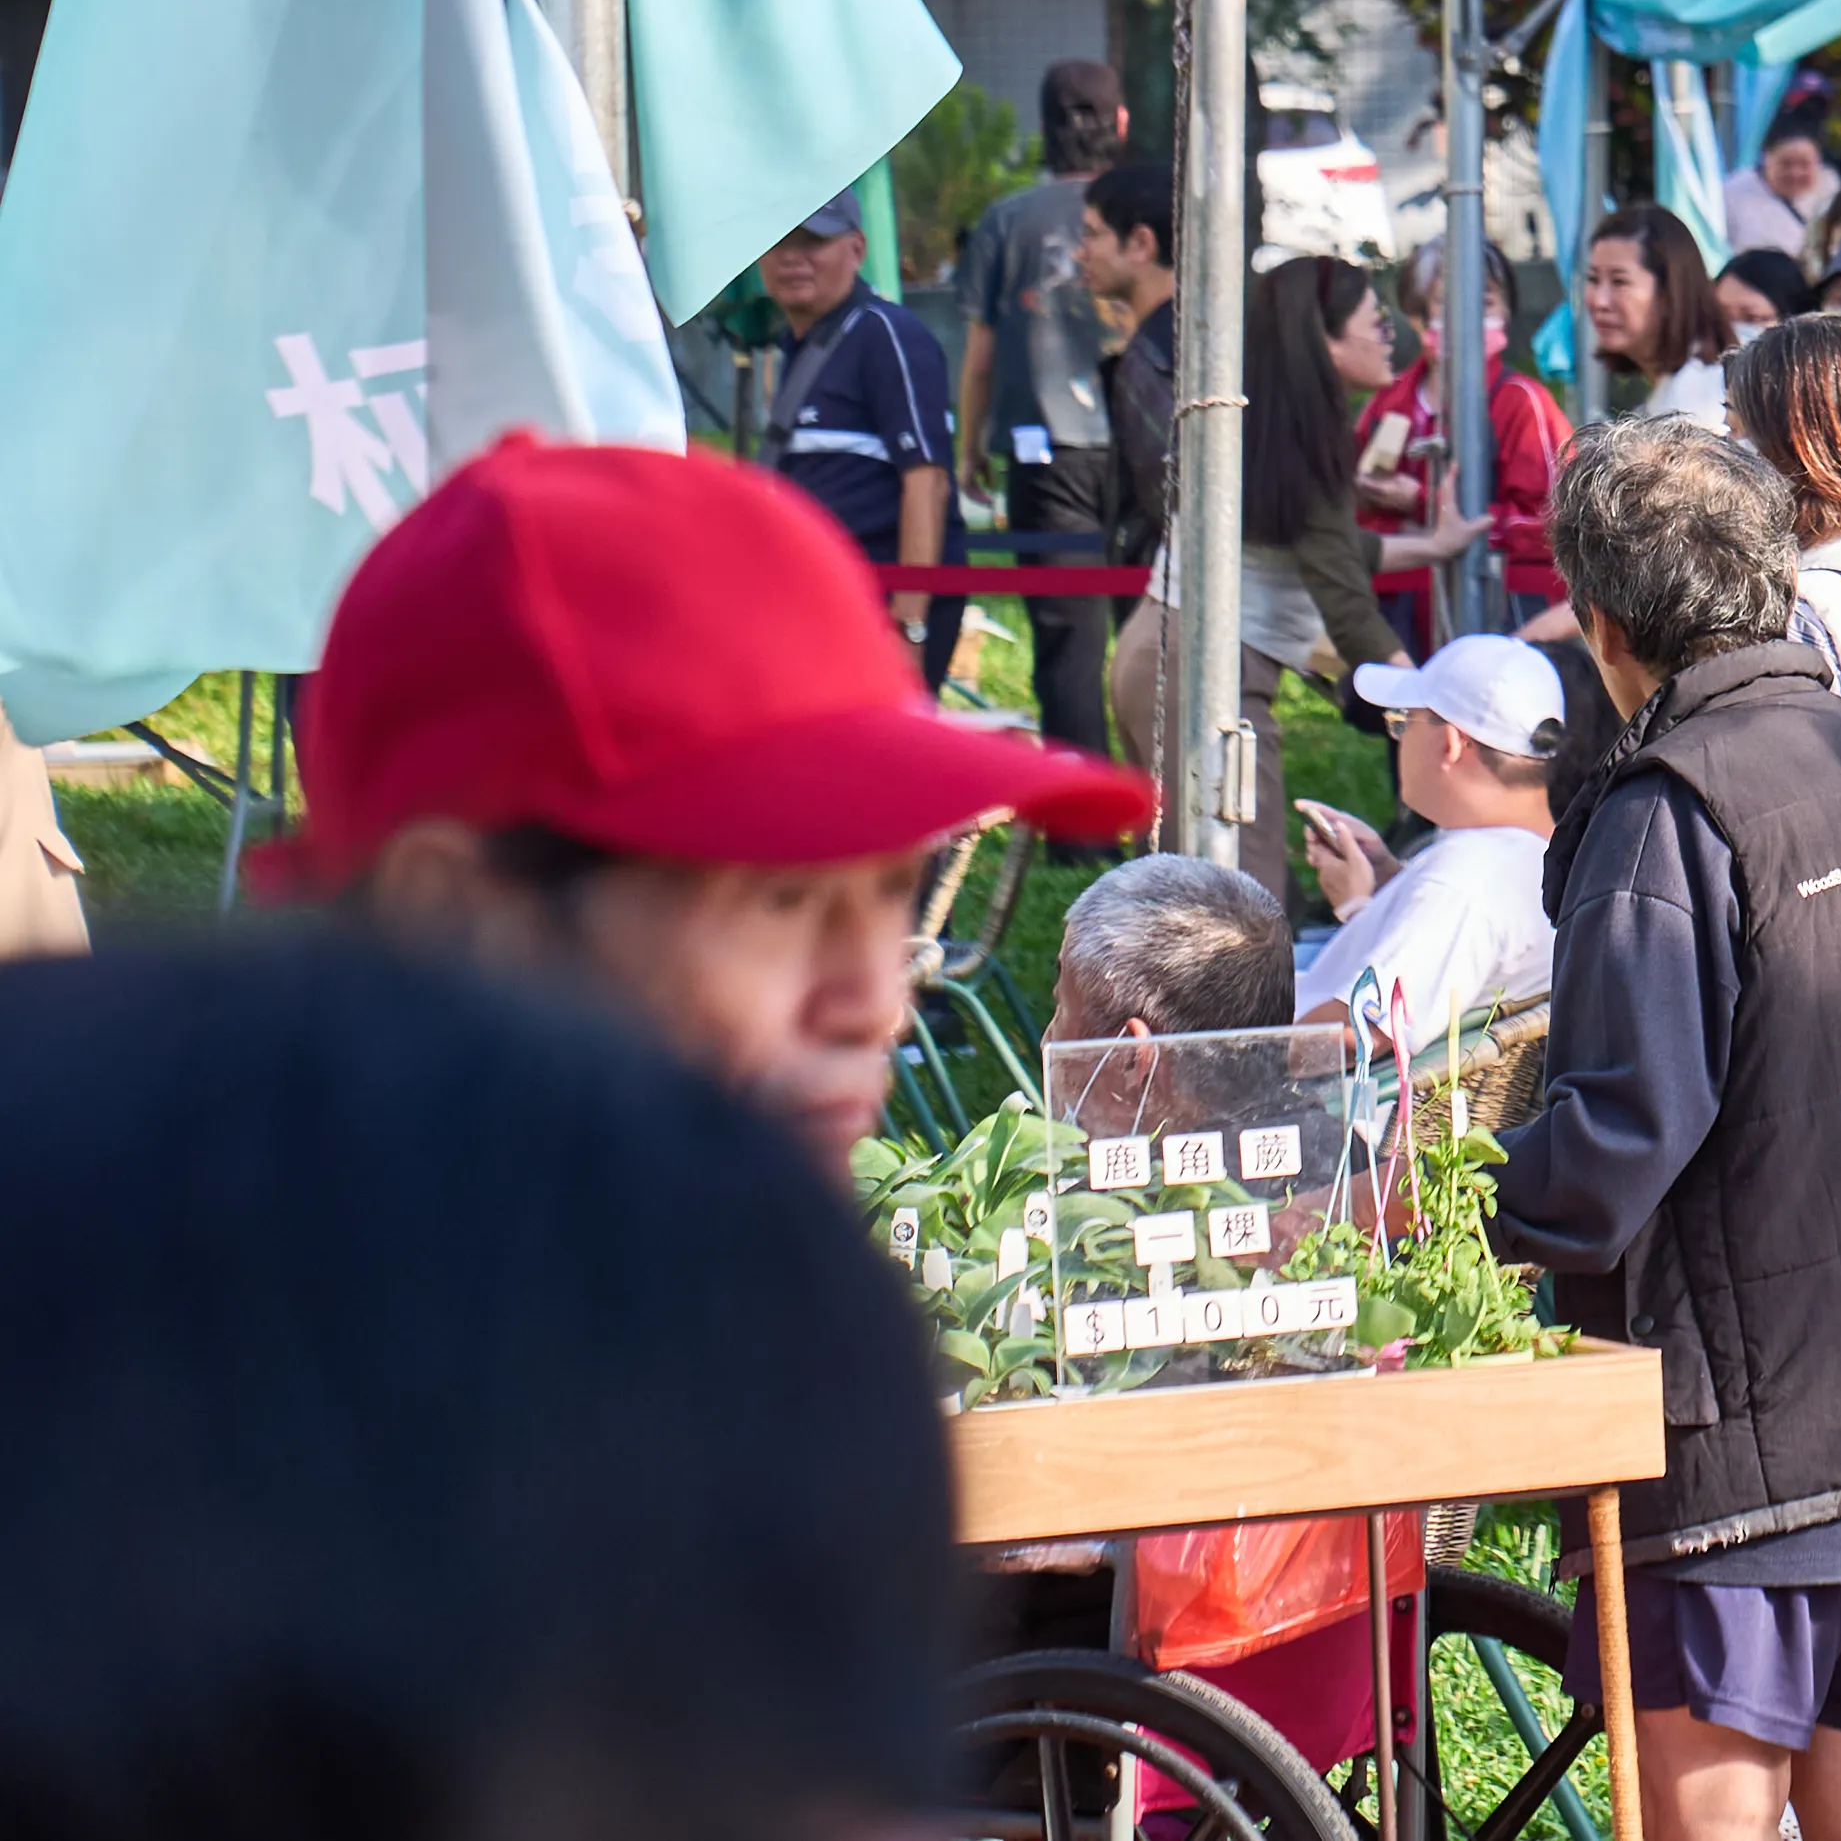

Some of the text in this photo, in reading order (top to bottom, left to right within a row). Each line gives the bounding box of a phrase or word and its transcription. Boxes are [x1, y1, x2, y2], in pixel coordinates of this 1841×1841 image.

[1103, 1133, 1289, 1182] 鹿角蕨
[1148, 1210, 1259, 1251] 一棵
[1085, 1286, 1345, 1356] $100元
